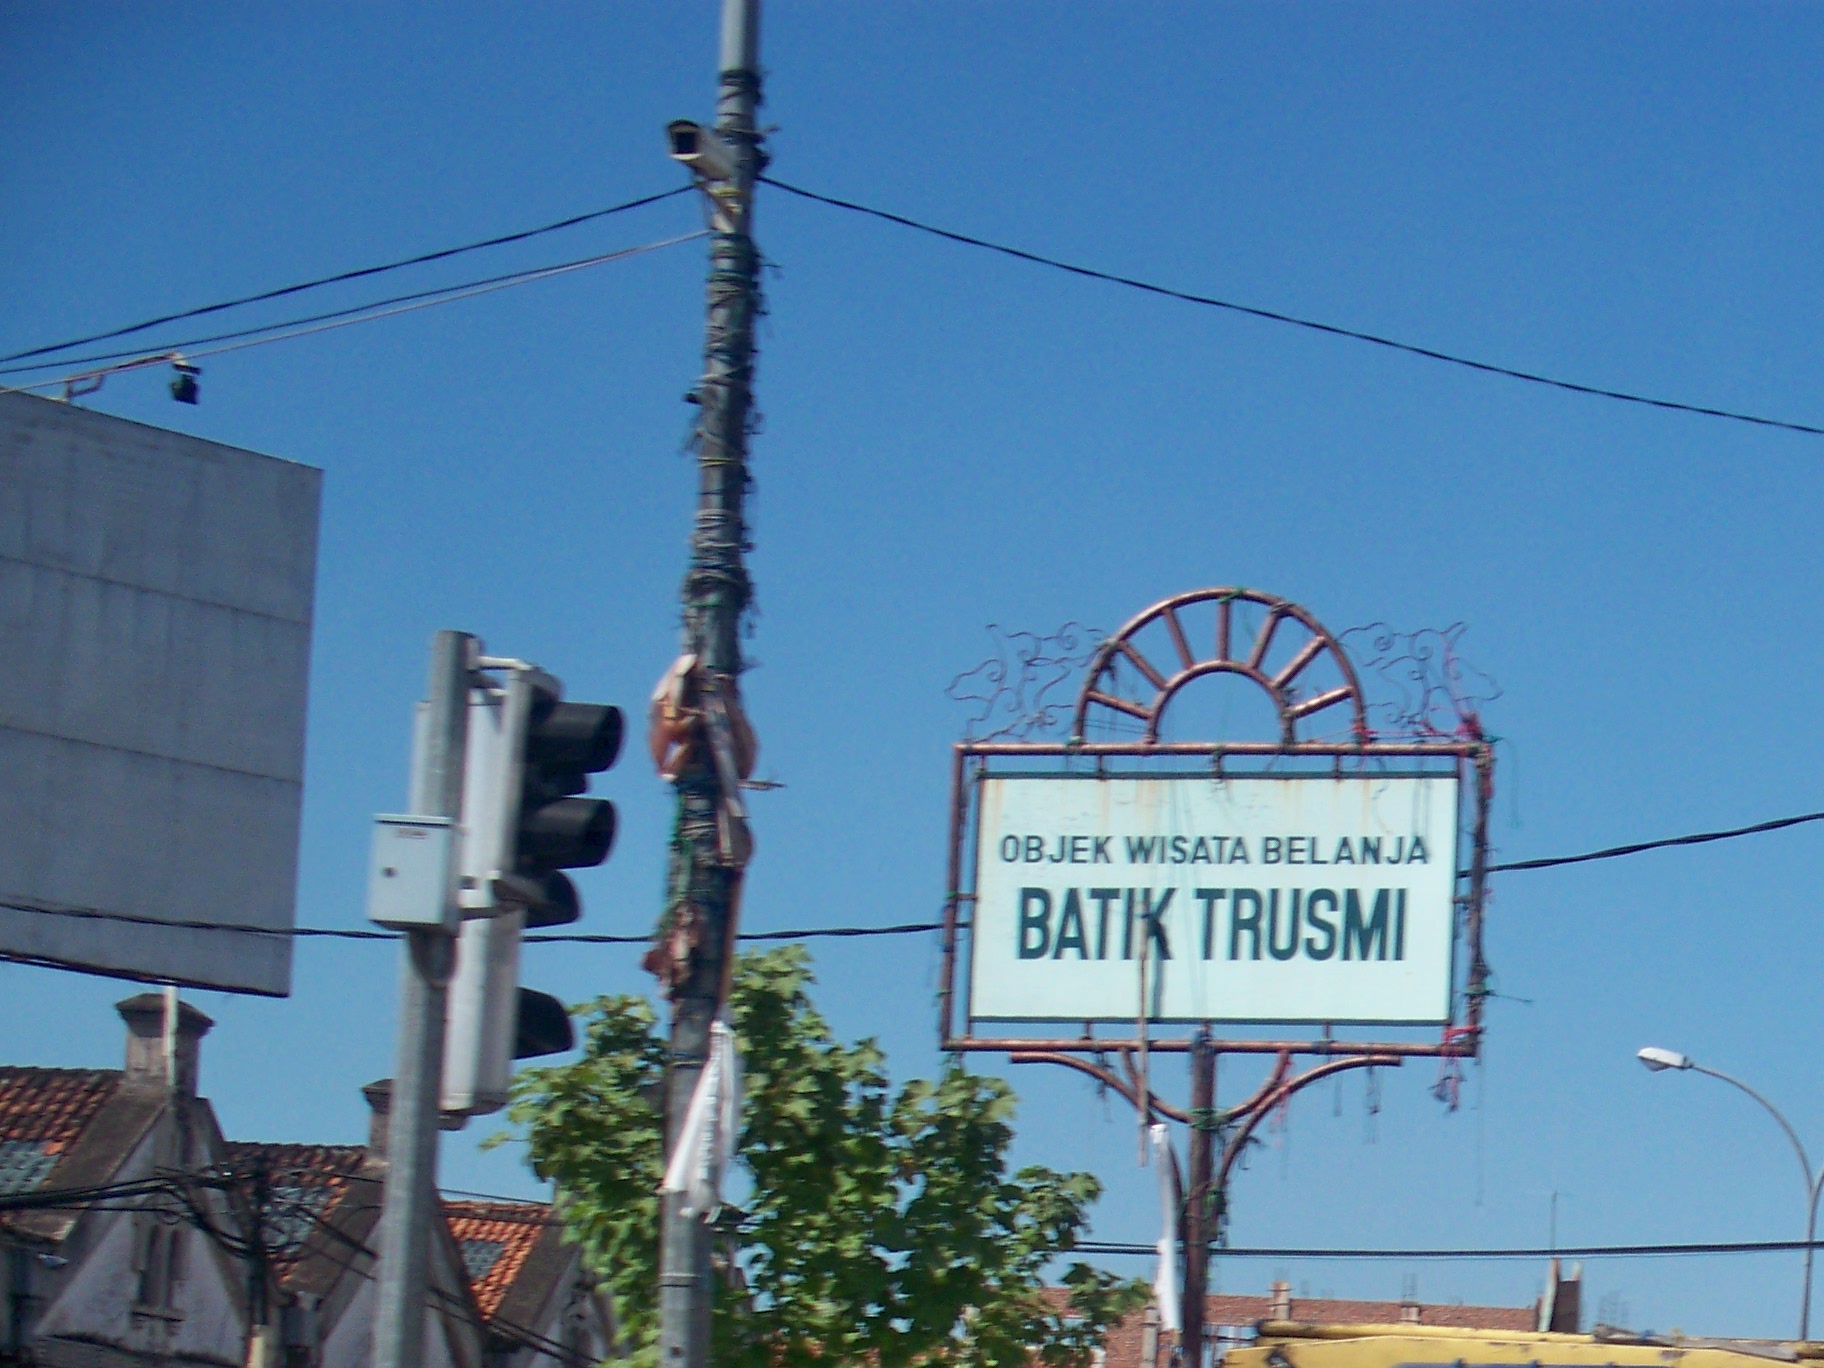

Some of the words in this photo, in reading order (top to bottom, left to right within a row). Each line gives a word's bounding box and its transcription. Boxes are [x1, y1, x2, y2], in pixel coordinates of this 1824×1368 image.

[1001, 834, 1114, 864] OBJEK
[1123, 835, 1249, 865] WISATA
[1263, 836, 1429, 865] BELANJA
[1016, 886, 1177, 961] BATIK
[1193, 886, 1409, 961] TRUSMI
